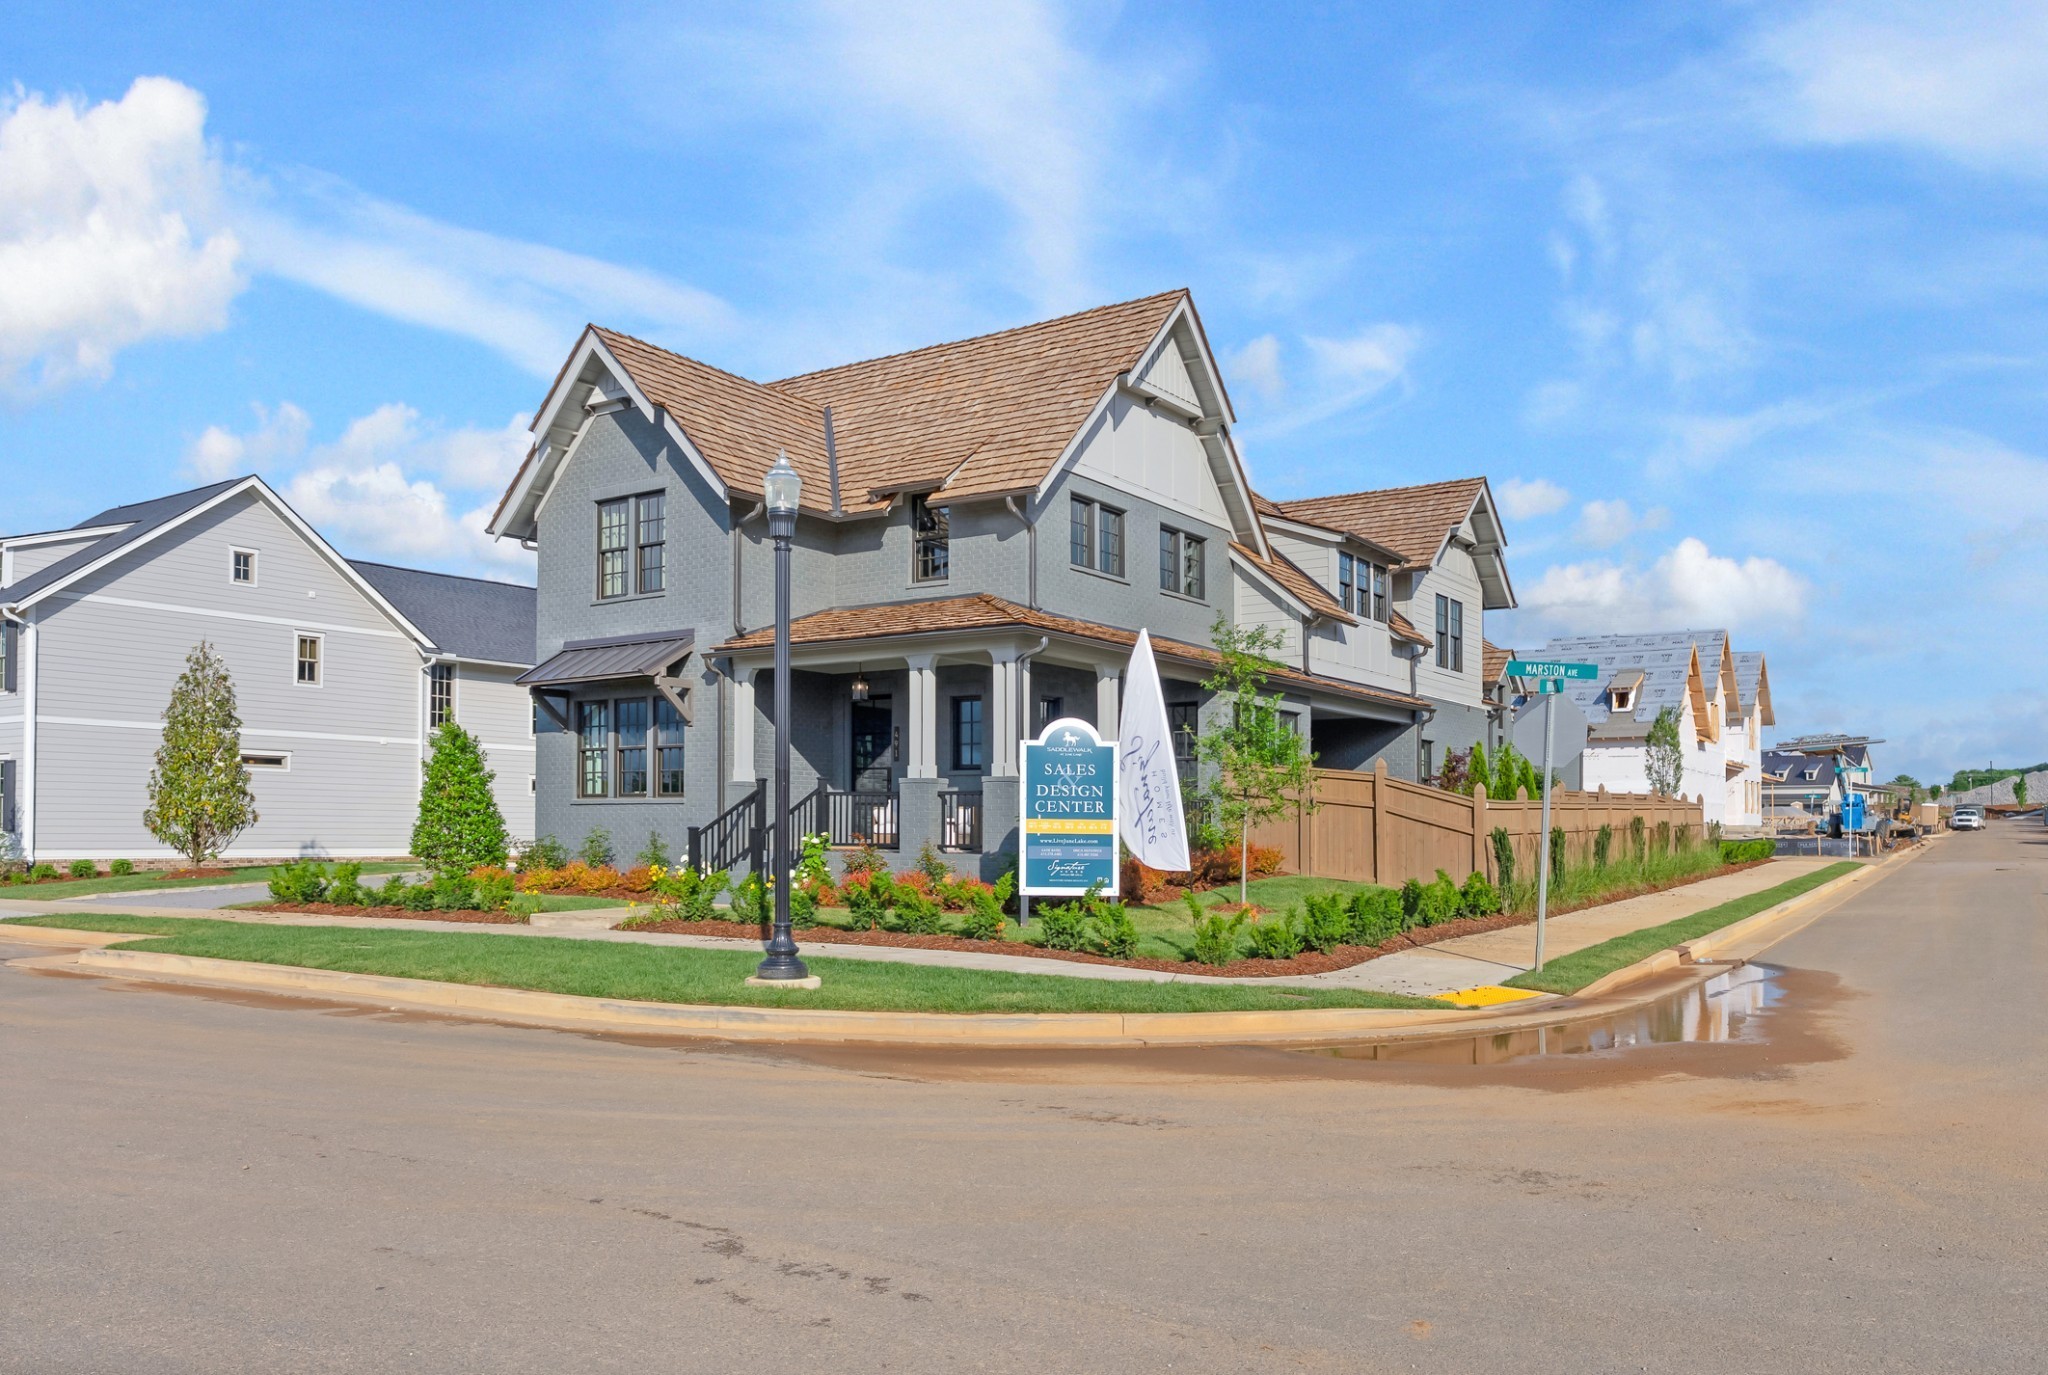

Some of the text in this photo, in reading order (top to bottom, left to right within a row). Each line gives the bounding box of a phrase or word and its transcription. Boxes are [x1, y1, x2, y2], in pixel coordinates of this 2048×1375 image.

[1525, 664, 1578, 677] MARSTON AVE
[1044, 763, 1096, 776] SALES
[1036, 784, 1104, 798] DESIGN
[1035, 800, 1105, 813] CENTER
